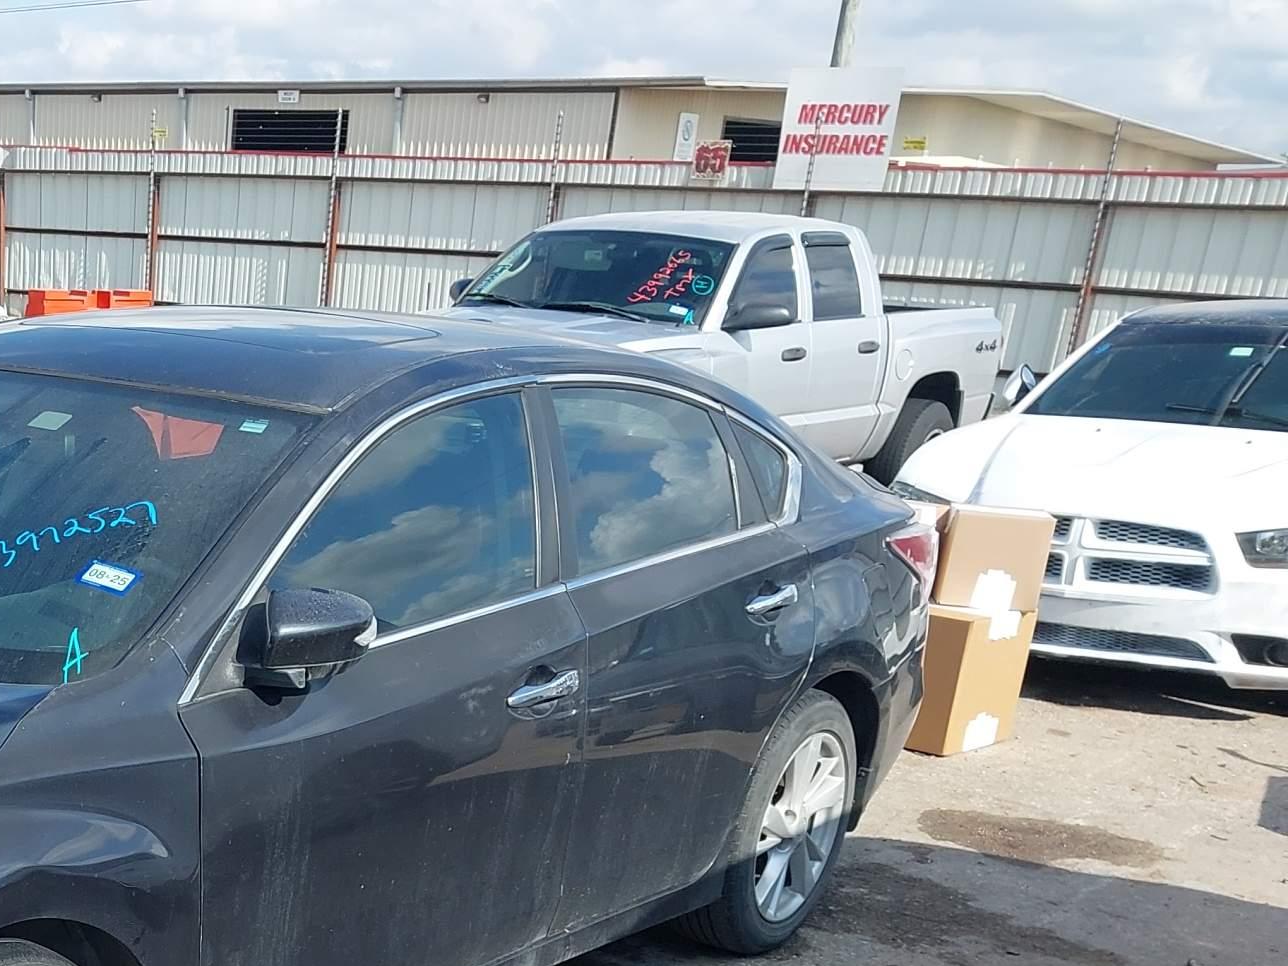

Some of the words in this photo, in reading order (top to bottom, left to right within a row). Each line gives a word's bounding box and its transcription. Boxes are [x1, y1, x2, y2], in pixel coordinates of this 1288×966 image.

[798, 104, 890, 125] MERCURY
[782, 134, 888, 155] INSURANCE
[976, 340, 997, 352] 4x4
[88, 568, 130, 586] 08-25
[63, 628, 89, 684] A
